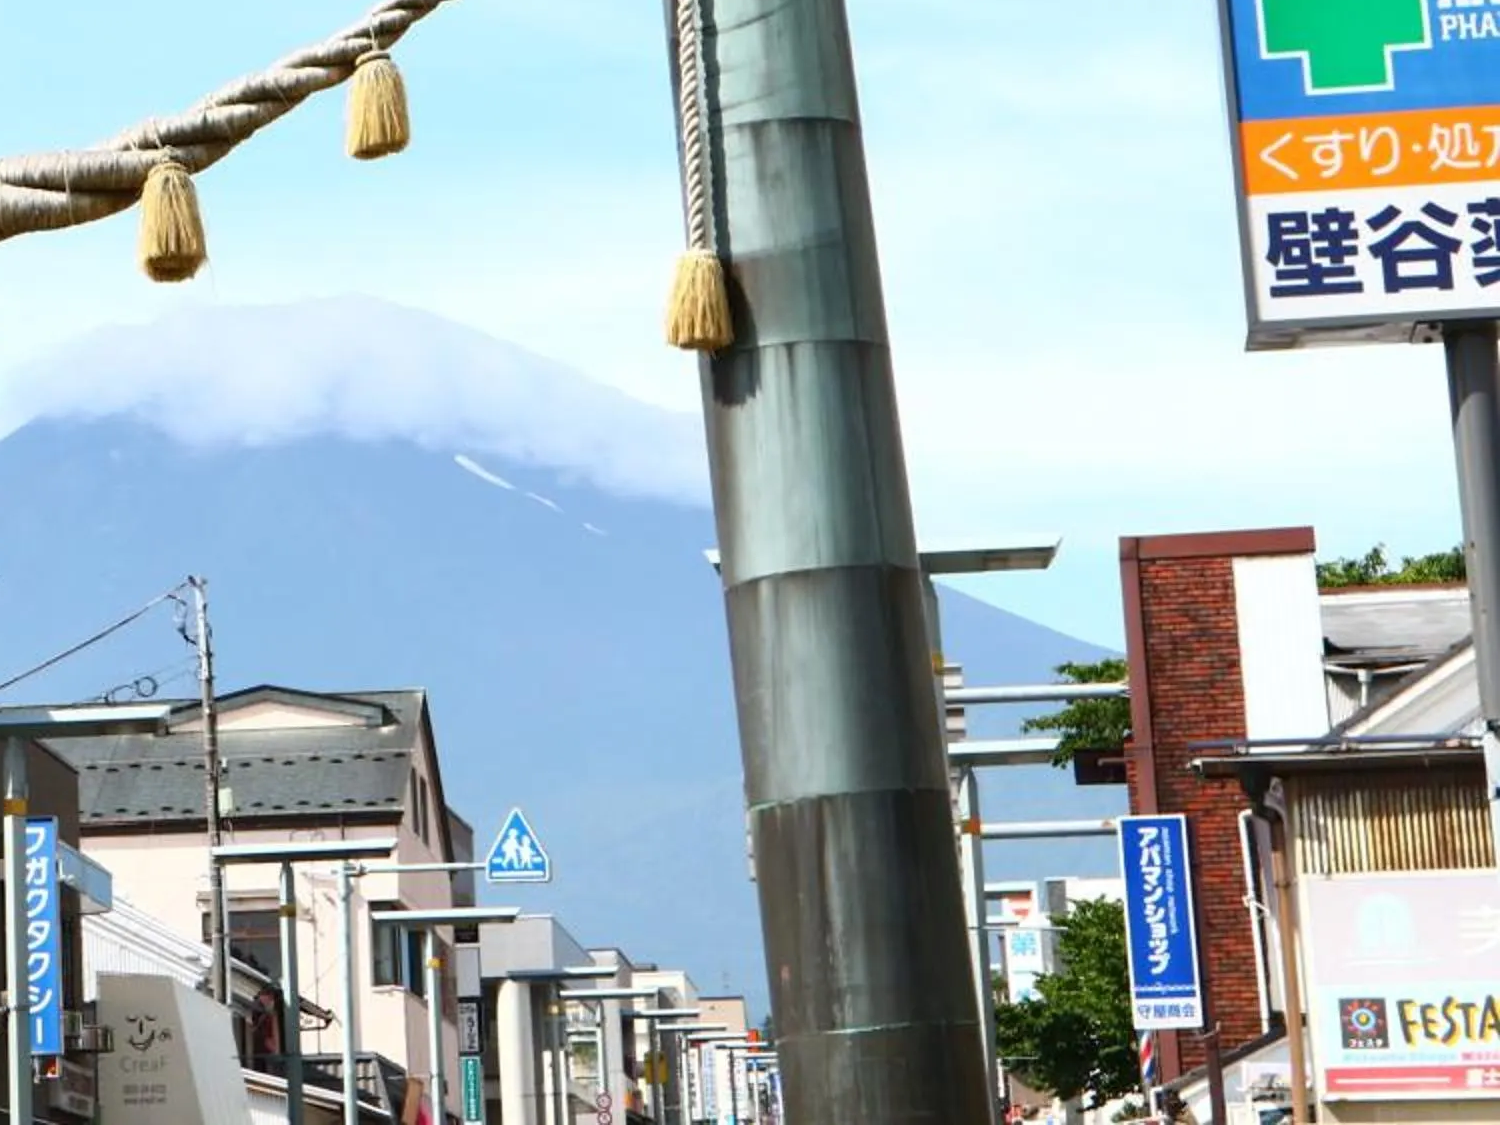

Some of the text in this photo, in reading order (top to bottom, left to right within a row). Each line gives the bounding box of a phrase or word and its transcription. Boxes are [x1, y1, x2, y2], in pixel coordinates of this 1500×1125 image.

[1439, 11, 1500, 42] PHA
[25, 826, 53, 1045] フガクタクシー
[1137, 826, 1171, 975] アパマンショップ
[1396, 994, 1500, 1046] FESTA
